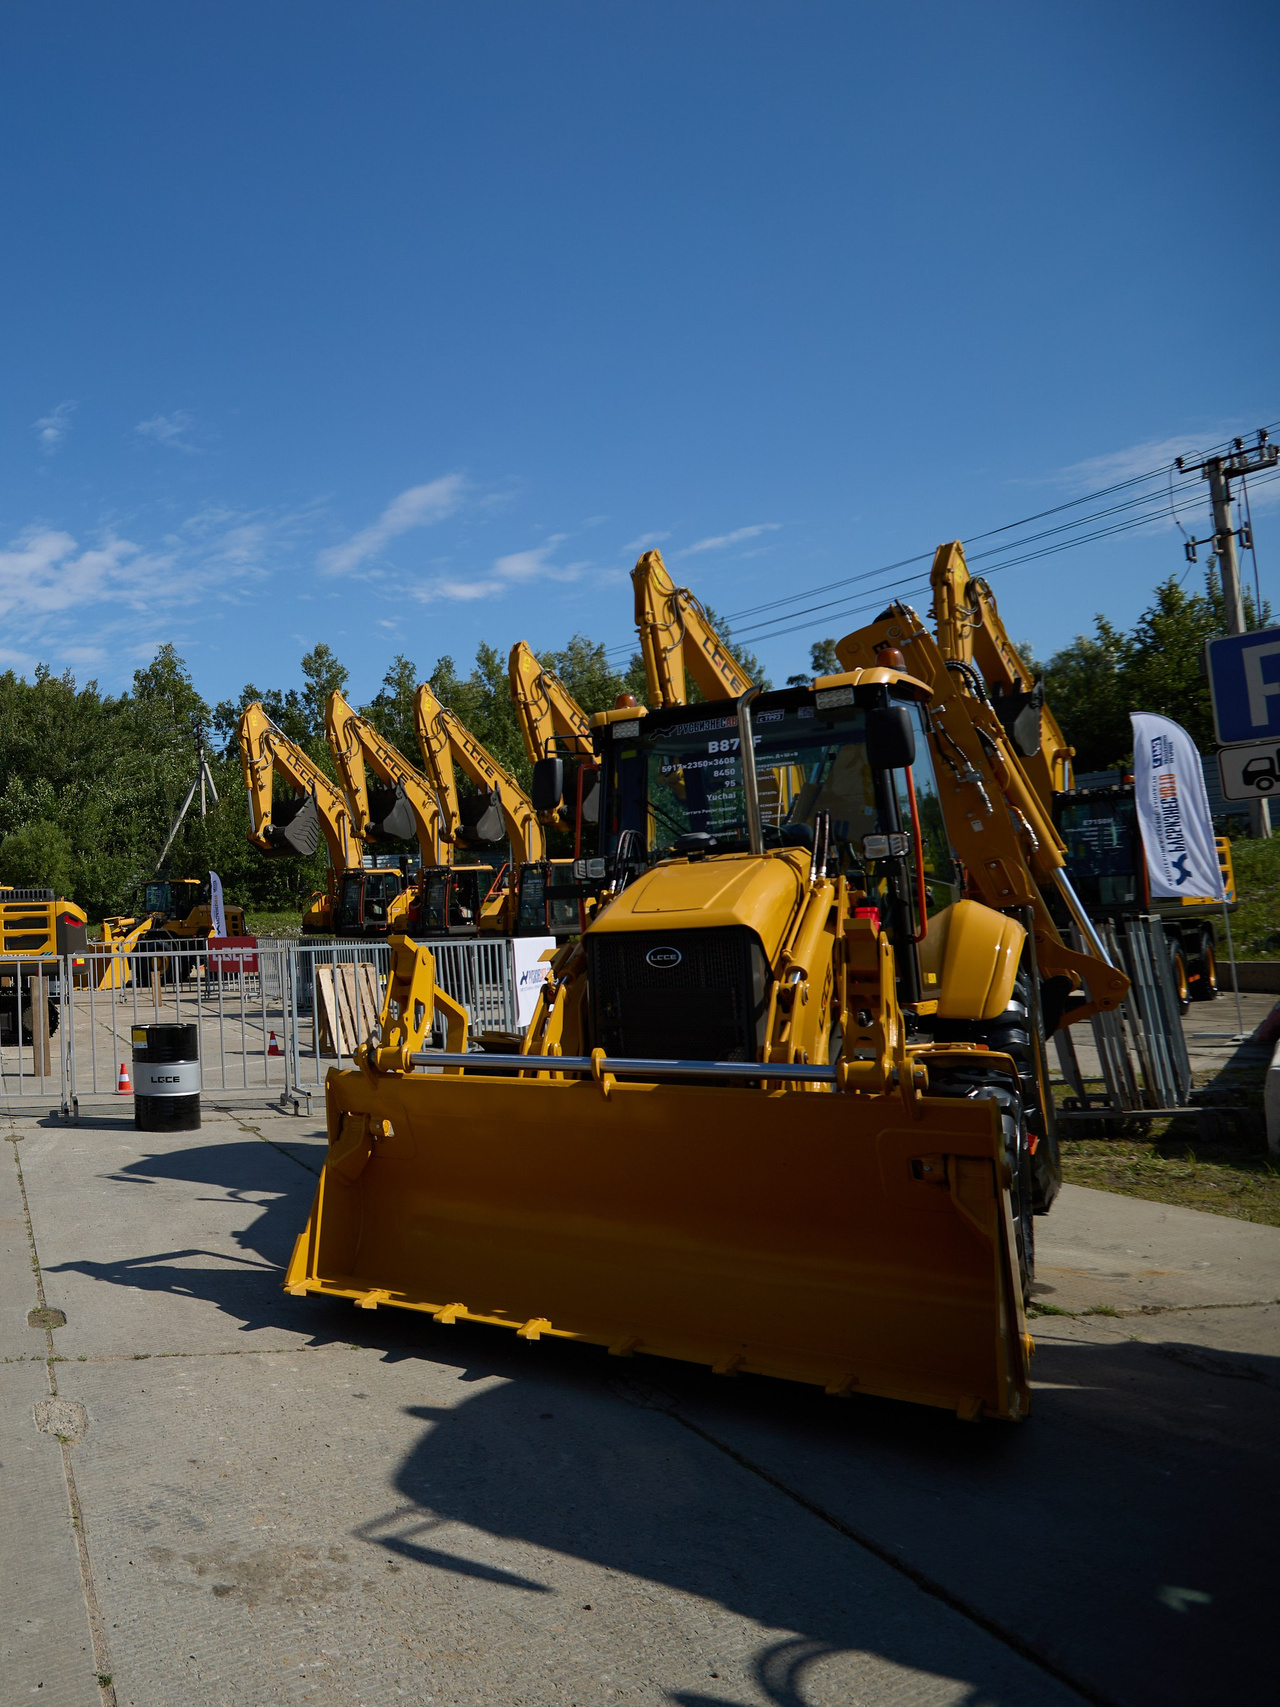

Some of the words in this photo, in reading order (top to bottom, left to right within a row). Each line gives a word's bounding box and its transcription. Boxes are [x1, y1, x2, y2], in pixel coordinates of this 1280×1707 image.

[677, 716, 739, 735] РУСБИЗНЕСАВ
[708, 735, 762, 753] B87F
[463, 740, 495, 779] LGCE
[713, 768, 735, 778] 8450
[706, 792, 736, 801] Yuchai
